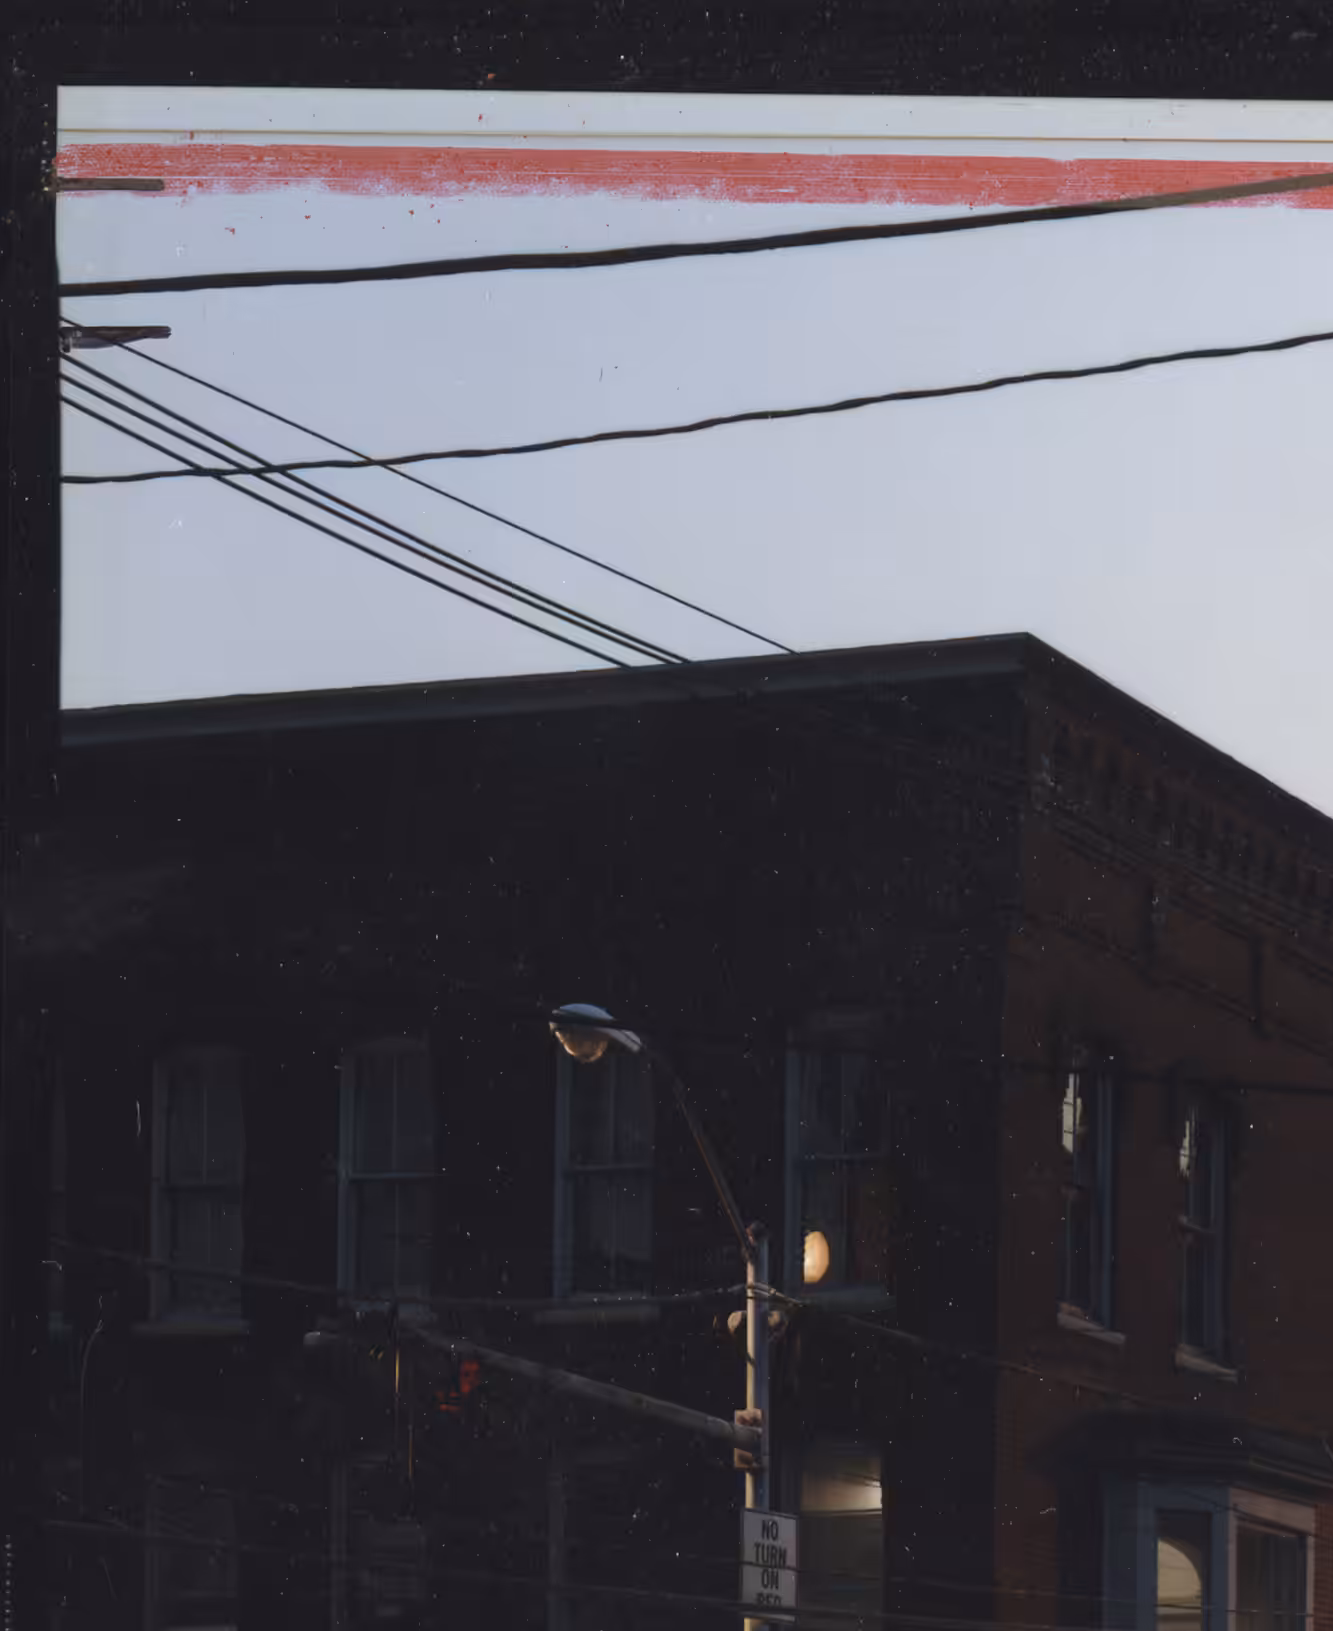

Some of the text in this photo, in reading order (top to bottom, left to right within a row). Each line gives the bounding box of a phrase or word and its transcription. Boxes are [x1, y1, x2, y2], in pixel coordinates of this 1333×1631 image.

[762, 1519, 779, 1541] NO
[754, 1541, 787, 1568] TURN
[762, 1568, 779, 1590] ON
